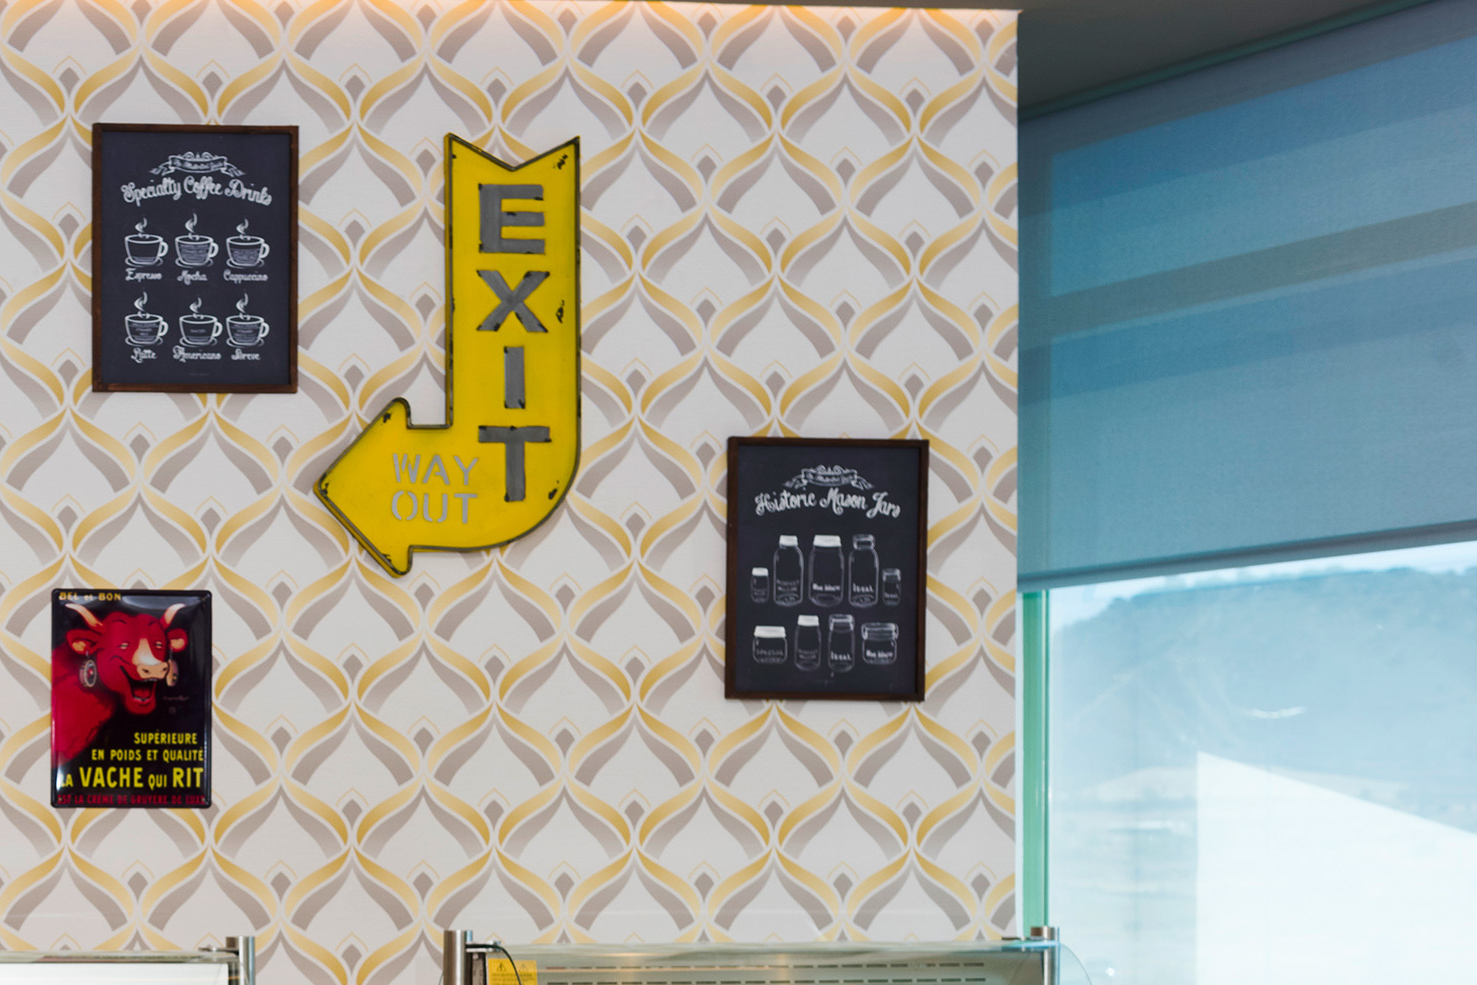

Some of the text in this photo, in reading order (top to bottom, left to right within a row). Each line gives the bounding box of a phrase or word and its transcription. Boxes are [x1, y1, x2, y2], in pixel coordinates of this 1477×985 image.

[121, 175, 273, 207] Specialty Coffee Drinks
[476, 183, 552, 502] EXIT
[392, 453, 479, 486] WAY
[390, 490, 478, 524] OUT
[754, 487, 901, 519] Historic Mason Jars
[133, 730, 198, 745] SUPÉRIEURE
[91, 746, 204, 763] EN POIDS ET QUALITÉ
[79, 766, 144, 788] VACHE
[172, 767, 204, 788] RIT
[74, 794, 85, 805] LA
[117, 794, 128, 805] DE
[171, 794, 182, 805] DE
